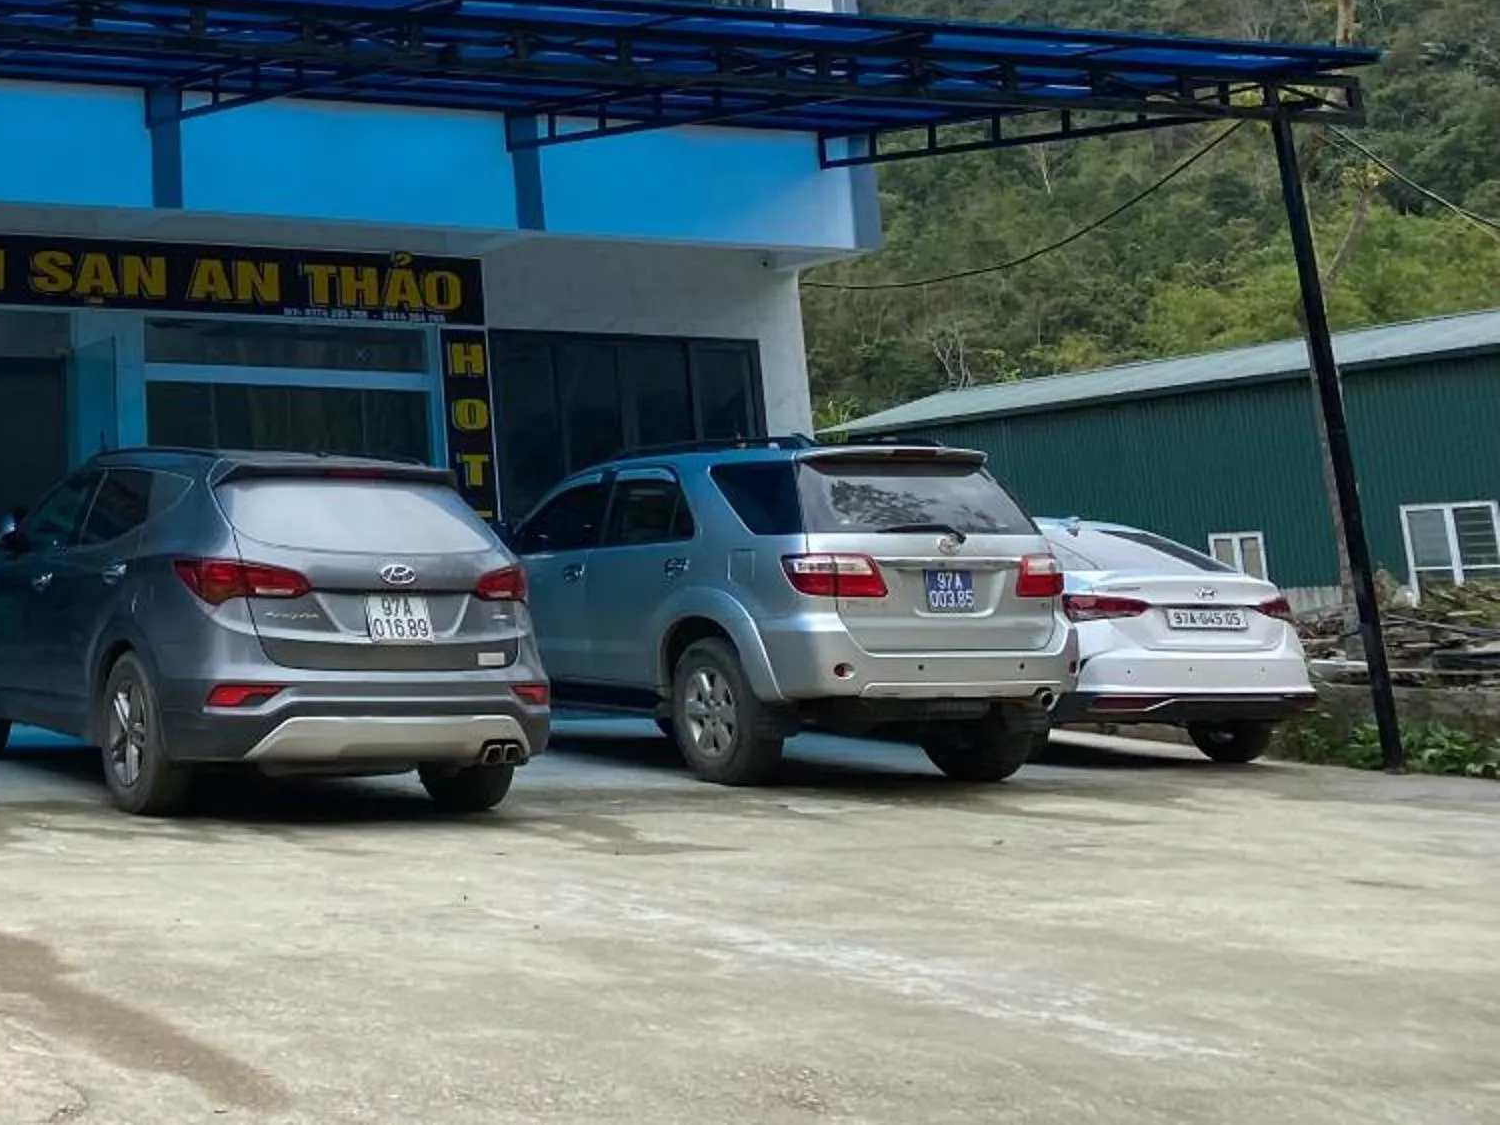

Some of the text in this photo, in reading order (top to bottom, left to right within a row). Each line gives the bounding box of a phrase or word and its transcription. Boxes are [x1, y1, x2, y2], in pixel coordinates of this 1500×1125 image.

[30, 250, 167, 304] SẠN
[187, 258, 280, 303] AN
[301, 250, 462, 311] THẢO
[937, 572, 964, 590] 97A
[381, 597, 413, 617] 97A
